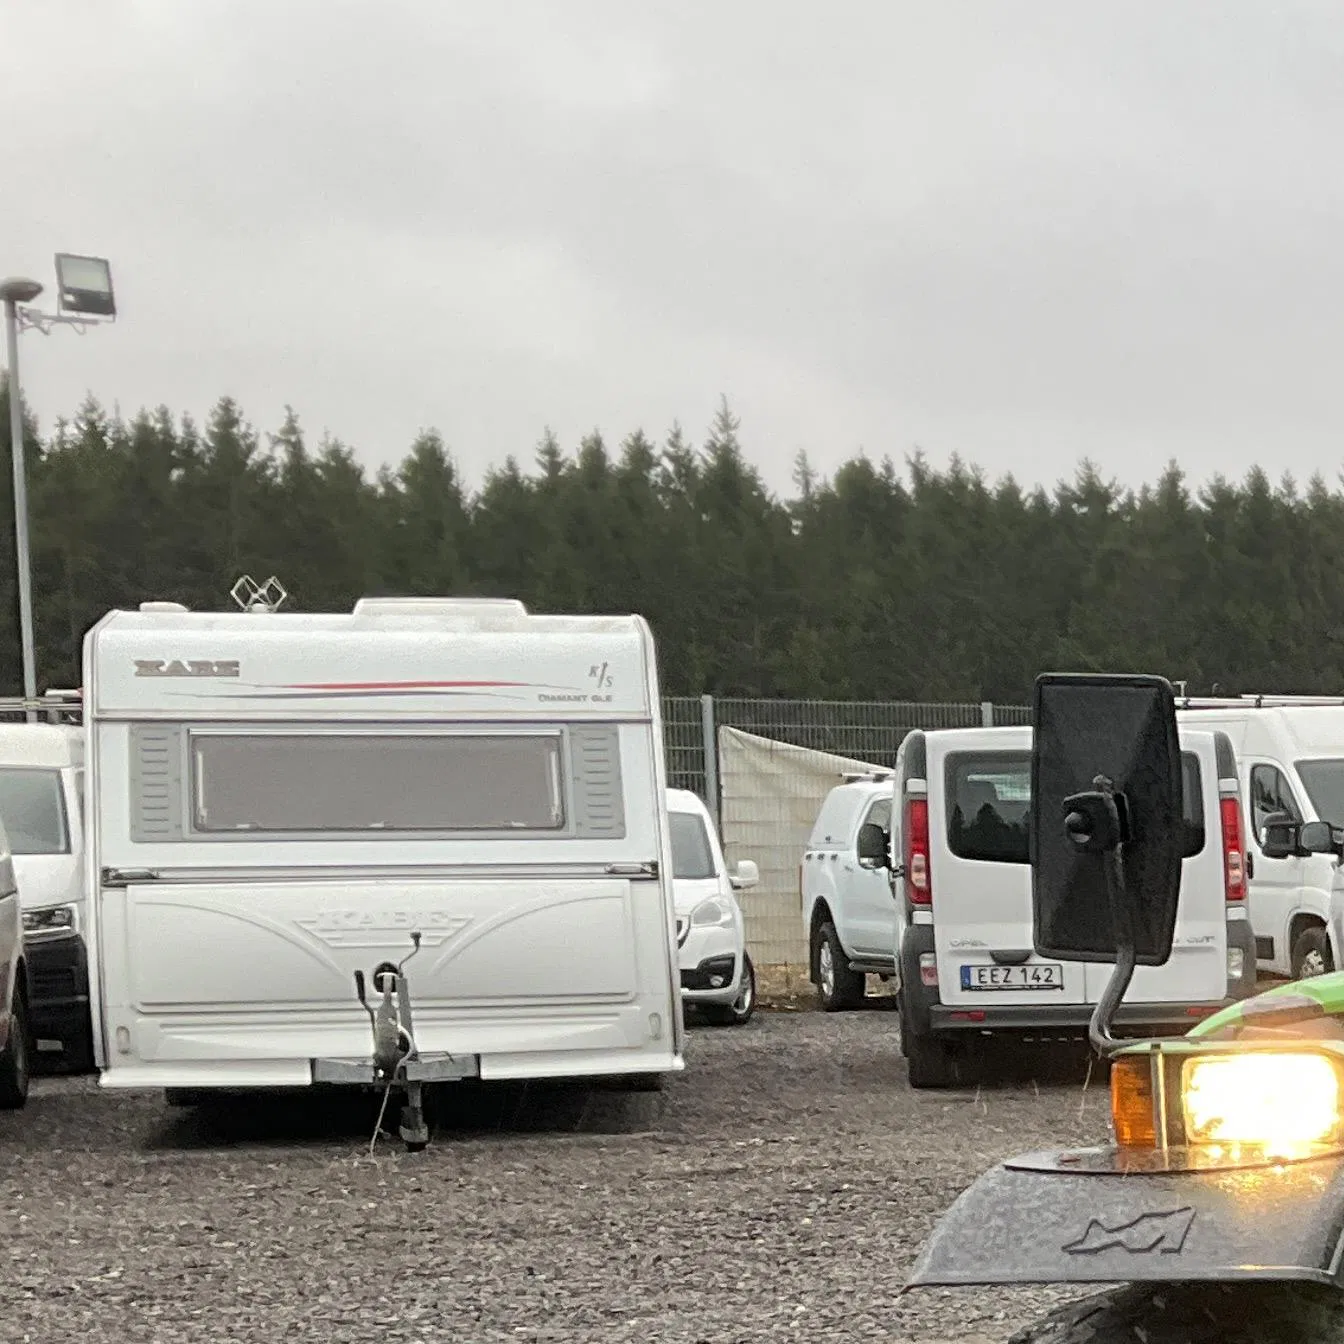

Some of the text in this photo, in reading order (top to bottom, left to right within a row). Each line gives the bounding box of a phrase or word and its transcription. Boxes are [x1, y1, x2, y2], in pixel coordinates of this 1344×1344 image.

[134, 660, 239, 677] KABE
[978, 966, 1054, 984] EEZ 142
